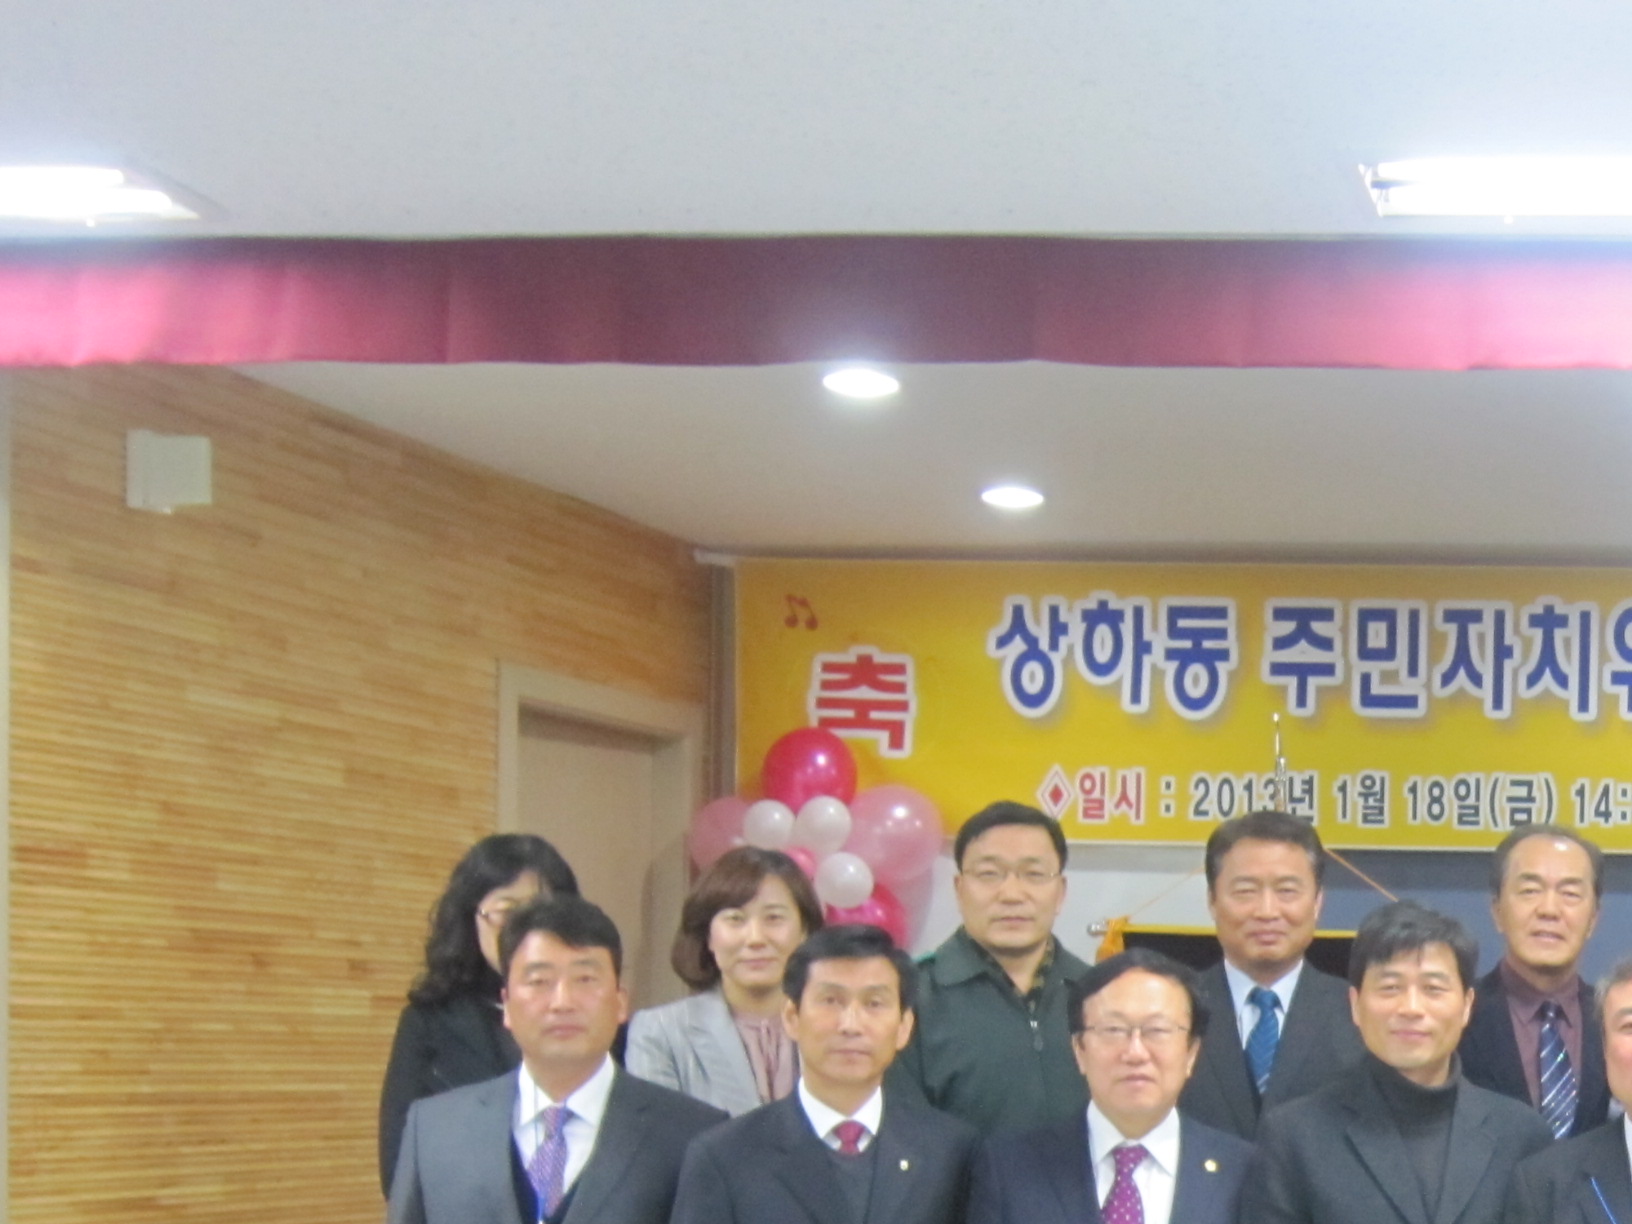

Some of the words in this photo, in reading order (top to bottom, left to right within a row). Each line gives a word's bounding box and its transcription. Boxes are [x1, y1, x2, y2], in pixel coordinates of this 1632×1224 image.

[815, 654, 910, 751] 축
[995, 599, 1231, 712] 상하동
[1078, 771, 1143, 821] 일시
[1337, 773, 1387, 825] 1월
[1407, 776, 1555, 828] 18일(금)
